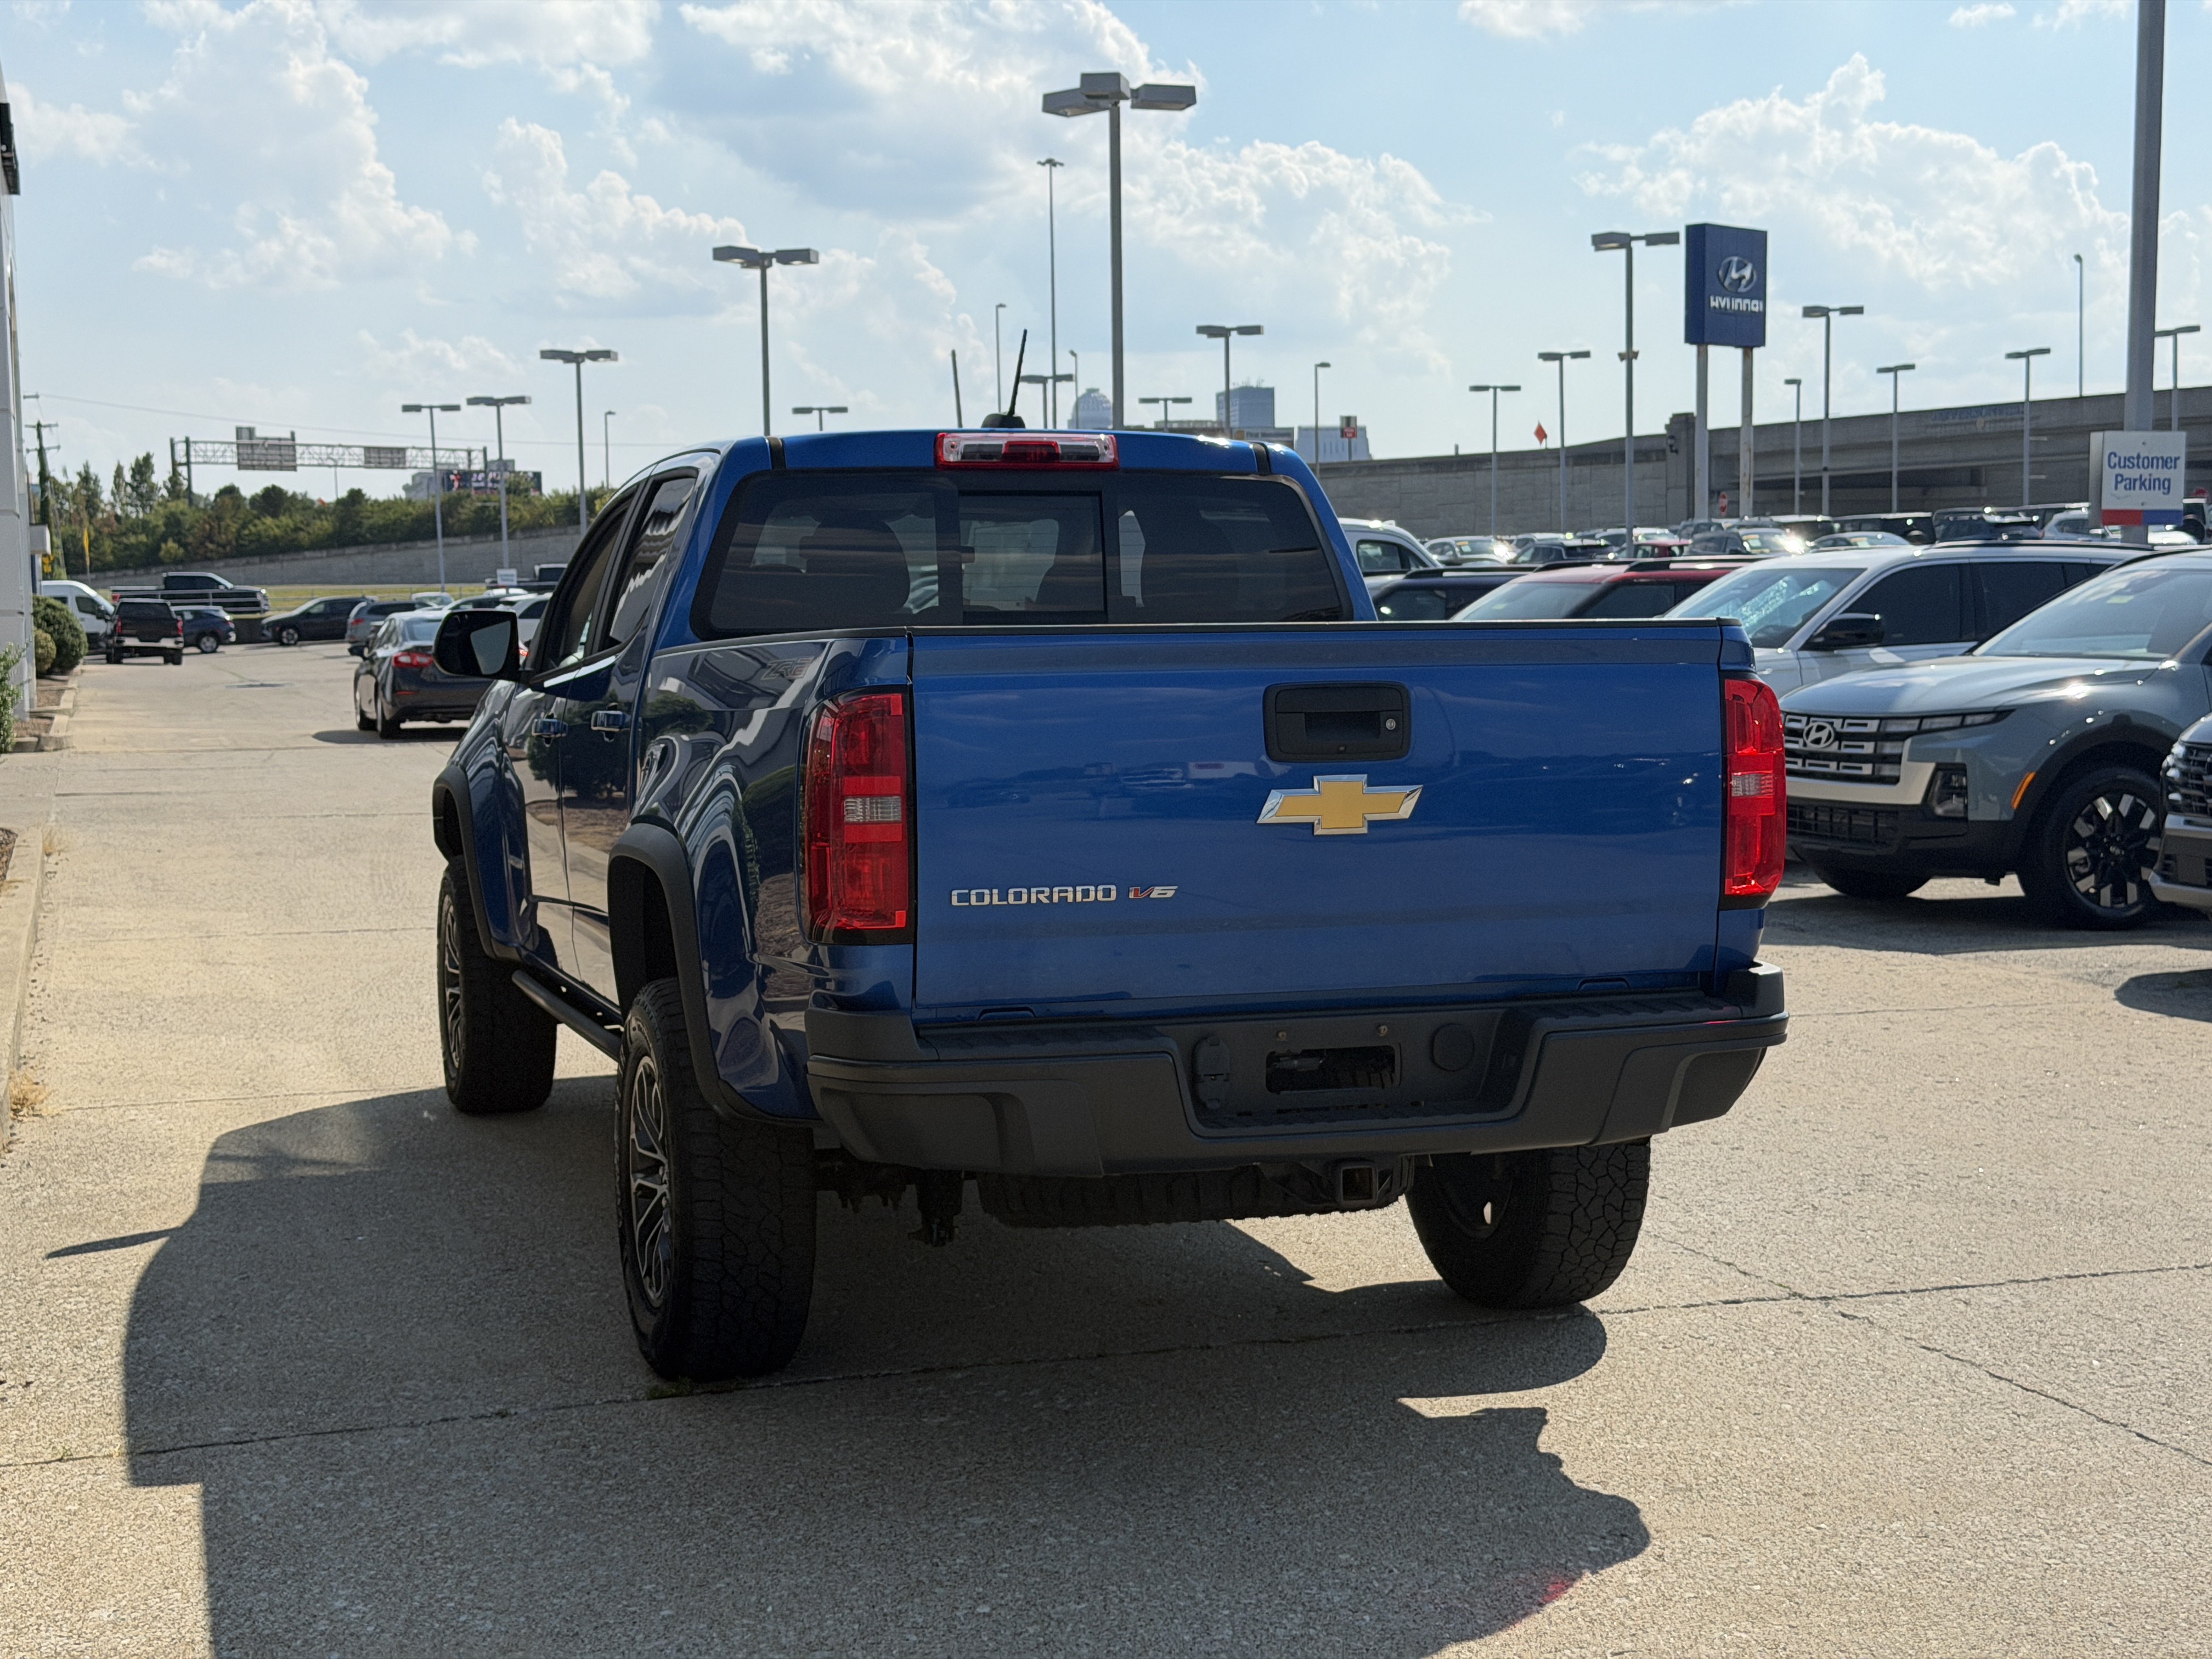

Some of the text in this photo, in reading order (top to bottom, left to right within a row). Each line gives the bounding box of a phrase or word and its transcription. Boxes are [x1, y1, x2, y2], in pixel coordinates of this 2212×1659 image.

[2107, 452, 2180, 470] Customer
[2114, 473, 2171, 495] Parking
[951, 884, 1178, 906] COLORADO V6
